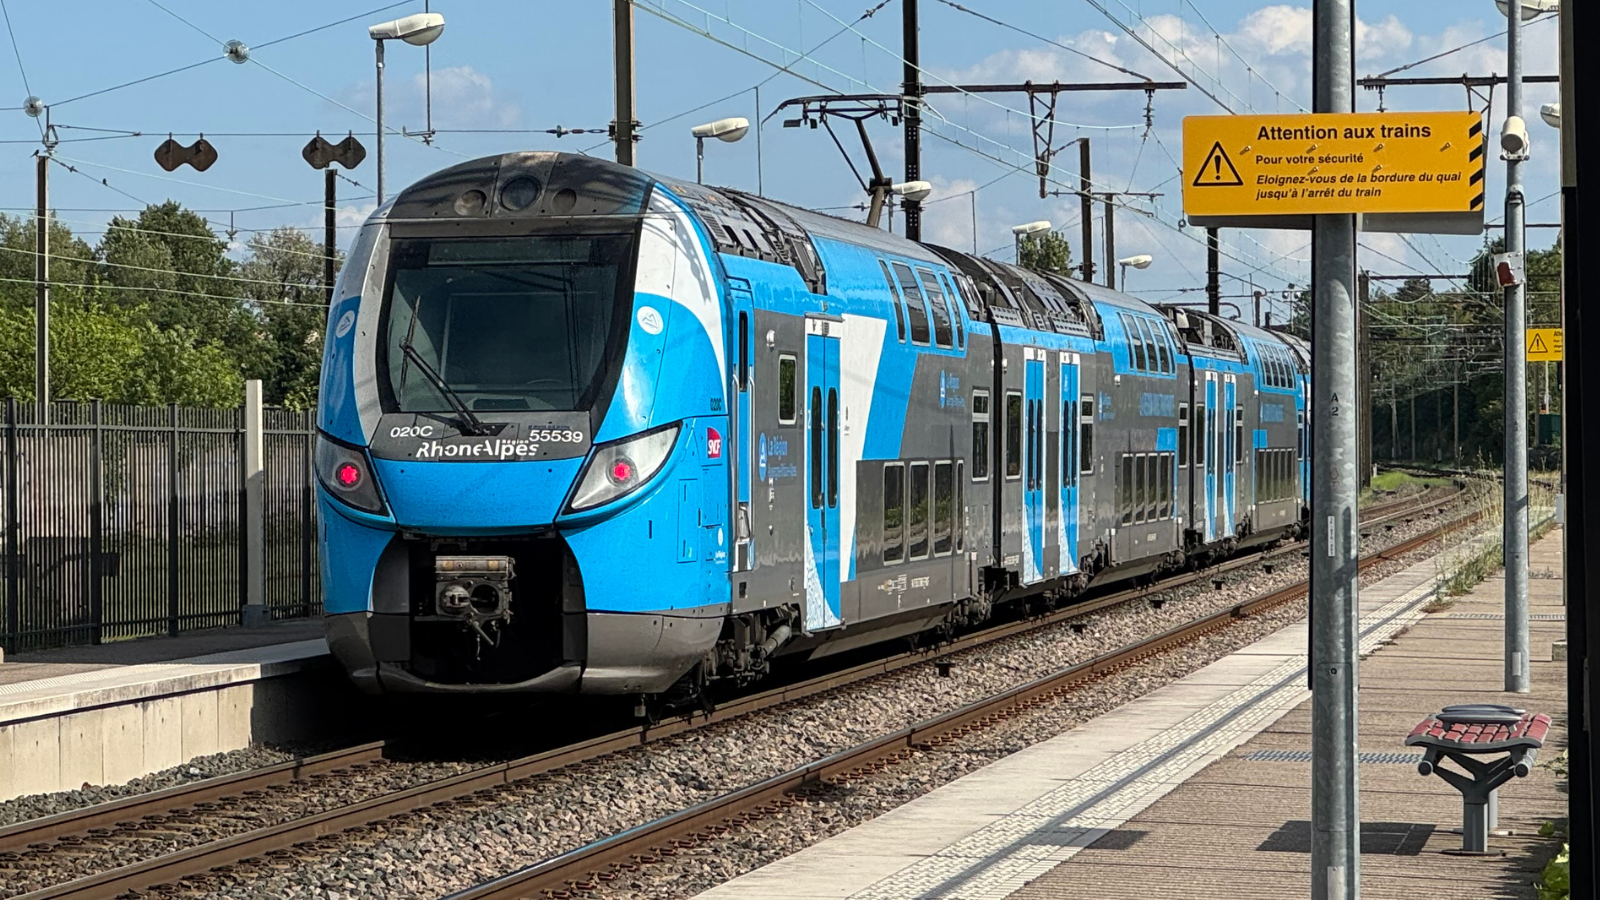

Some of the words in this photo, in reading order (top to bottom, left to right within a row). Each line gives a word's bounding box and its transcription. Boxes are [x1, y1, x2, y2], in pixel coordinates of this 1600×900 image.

[1257, 125, 1338, 140] Attention
[1343, 127, 1375, 139] aux
[1380, 123, 1431, 138] trains
[1256, 155, 1282, 164] Pour
[1286, 155, 1315, 164] votre
[1318, 153, 1364, 163] sécurité
[1256, 174, 1337, 187] Eloignez-vous
[1340, 173, 1354, 183] de
[1357, 173, 1367, 183] la
[1370, 172, 1415, 183] bordure
[1418, 172, 1433, 182] du
[1436, 171, 1462, 184] quai
[1338, 188, 1352, 198] du
[1355, 187, 1381, 197] train
[390, 425, 434, 438] 020C
[528, 429, 584, 443] 55539
